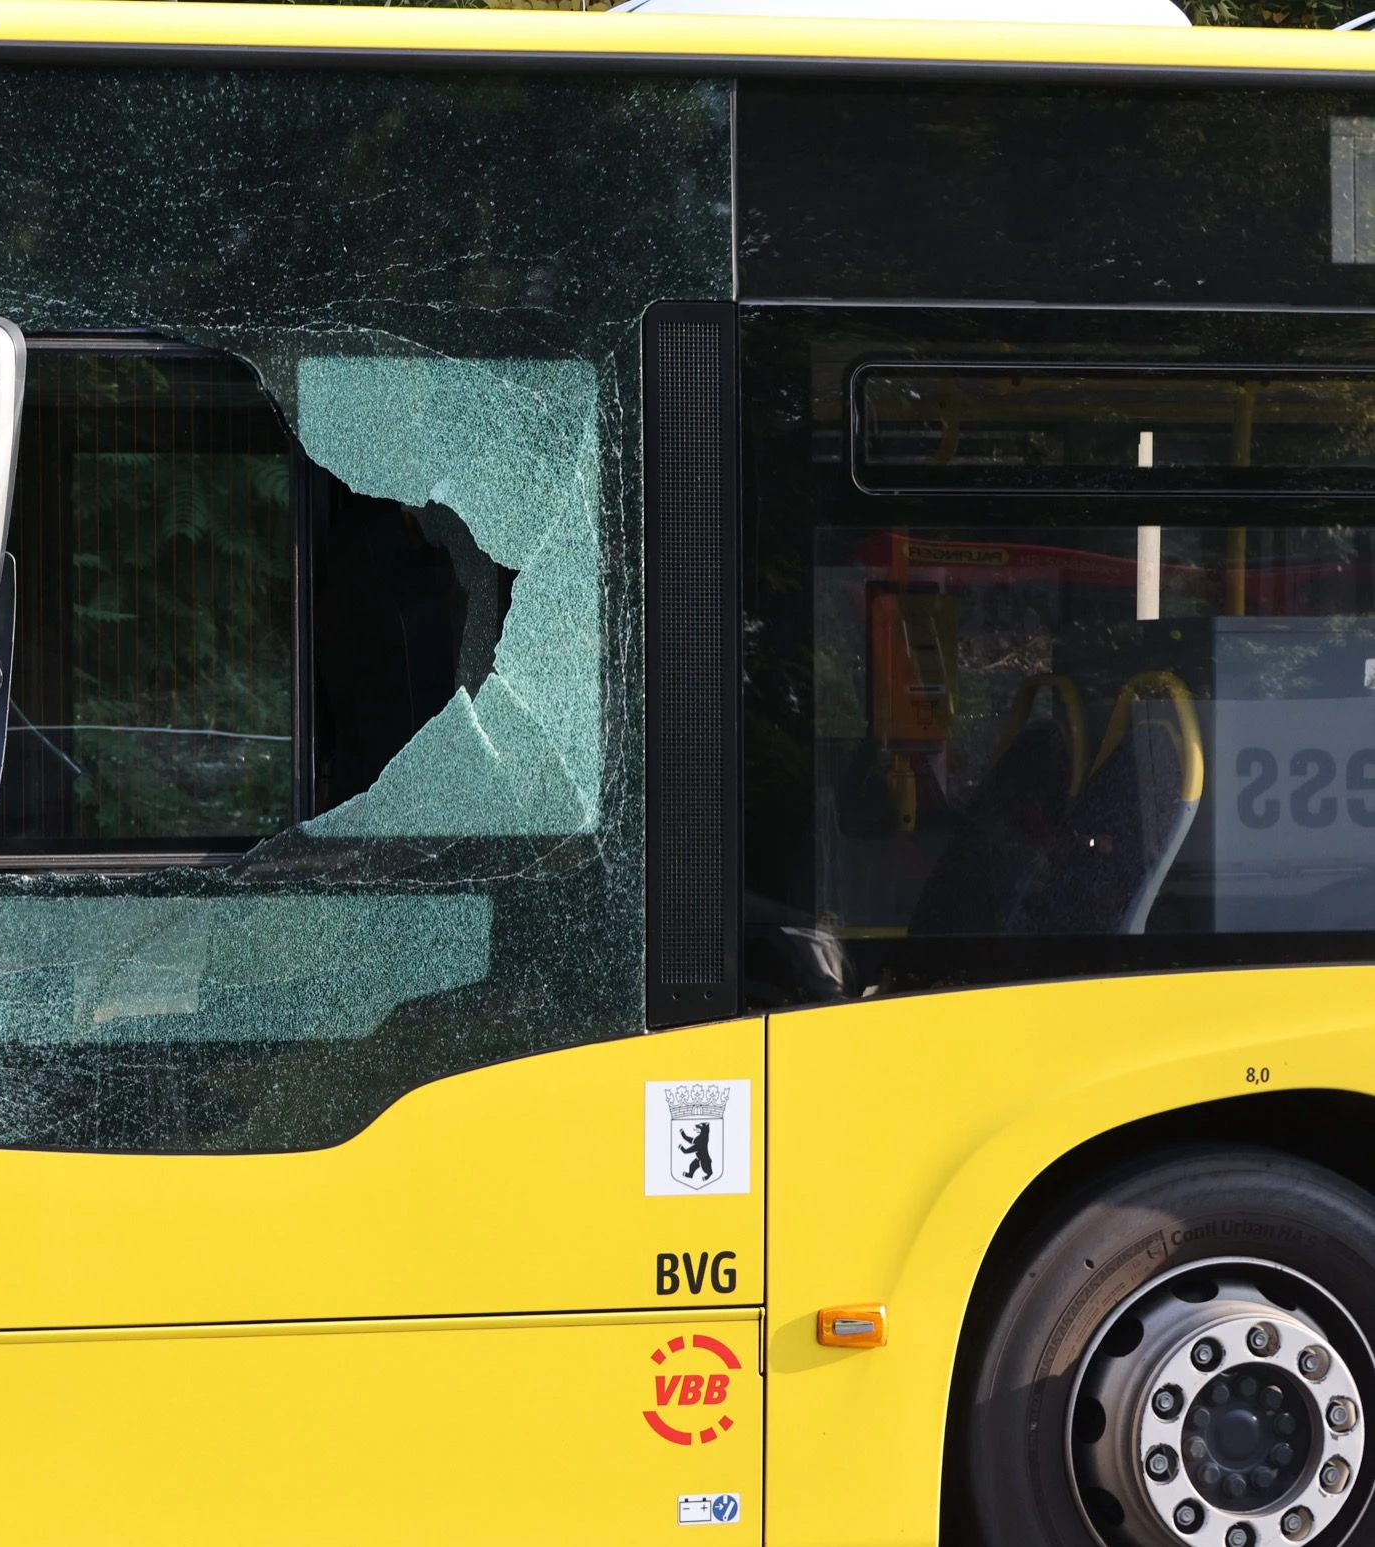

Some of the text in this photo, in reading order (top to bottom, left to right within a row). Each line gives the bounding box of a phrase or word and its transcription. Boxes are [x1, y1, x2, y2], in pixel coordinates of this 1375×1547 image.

[1246, 1067, 1270, 1085] 8,0
[1171, 1220, 1217, 1246] Conti
[1221, 1219, 1275, 1241] Urban
[656, 1251, 737, 1295] BVG
[655, 1374, 730, 1406] VBB
